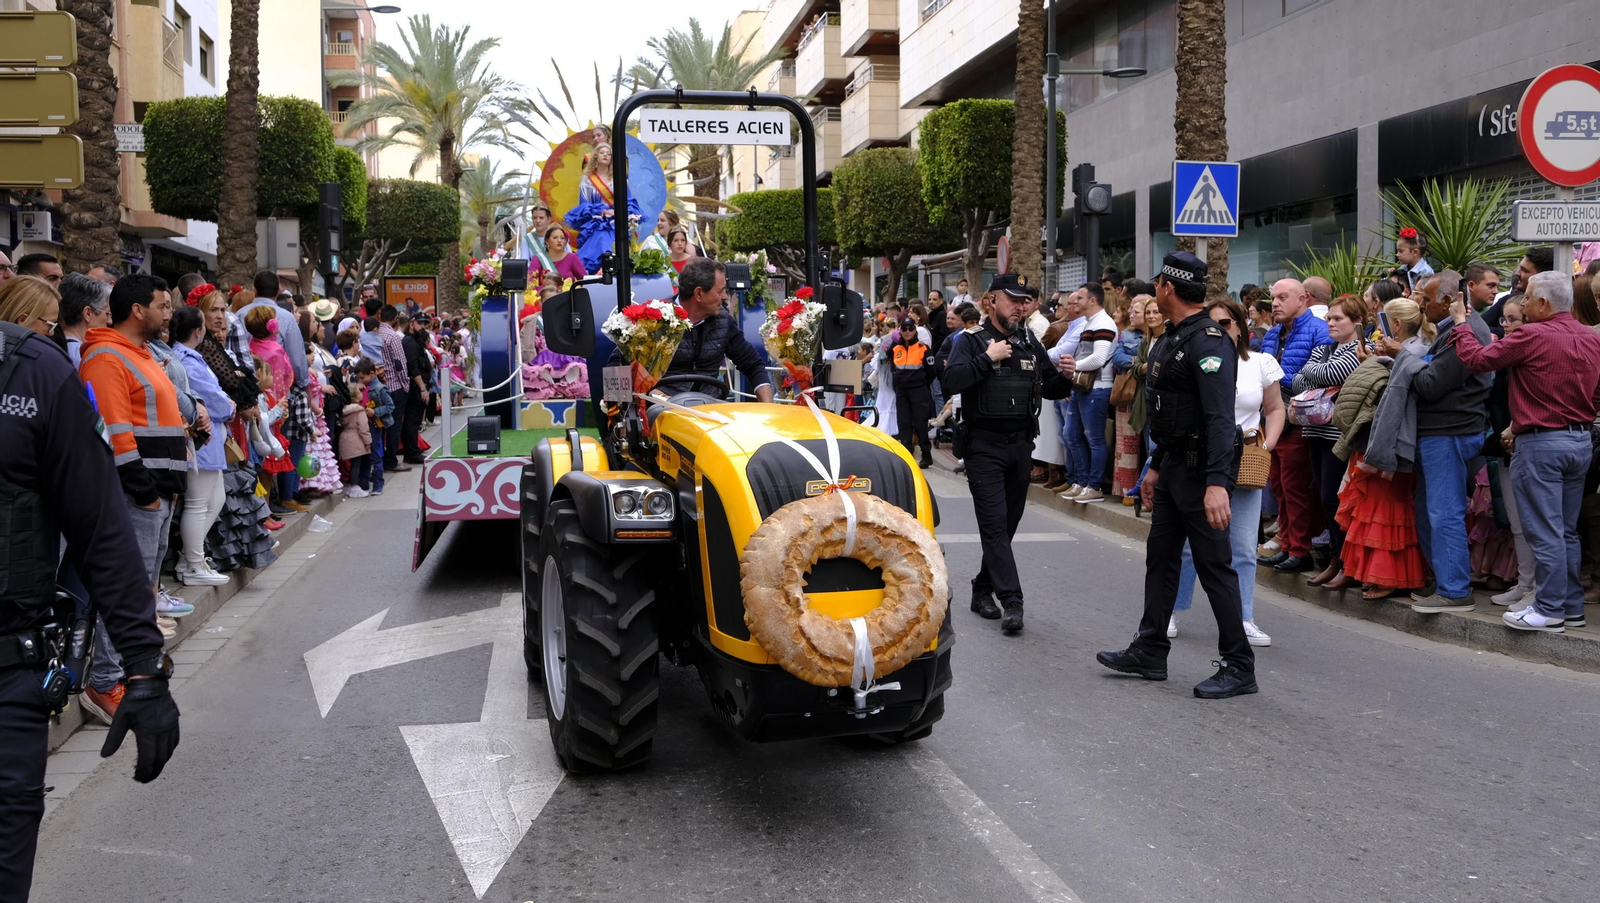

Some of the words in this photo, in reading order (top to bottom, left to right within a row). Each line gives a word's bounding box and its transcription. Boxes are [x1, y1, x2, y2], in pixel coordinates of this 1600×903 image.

[648, 119, 729, 134] TALLERES
[736, 121, 784, 135] ACIEN
[1521, 207, 1564, 220] EXCEPTO
[1536, 222, 1600, 235] AUTORIZADO
[0, 393, 38, 412] ICIA
